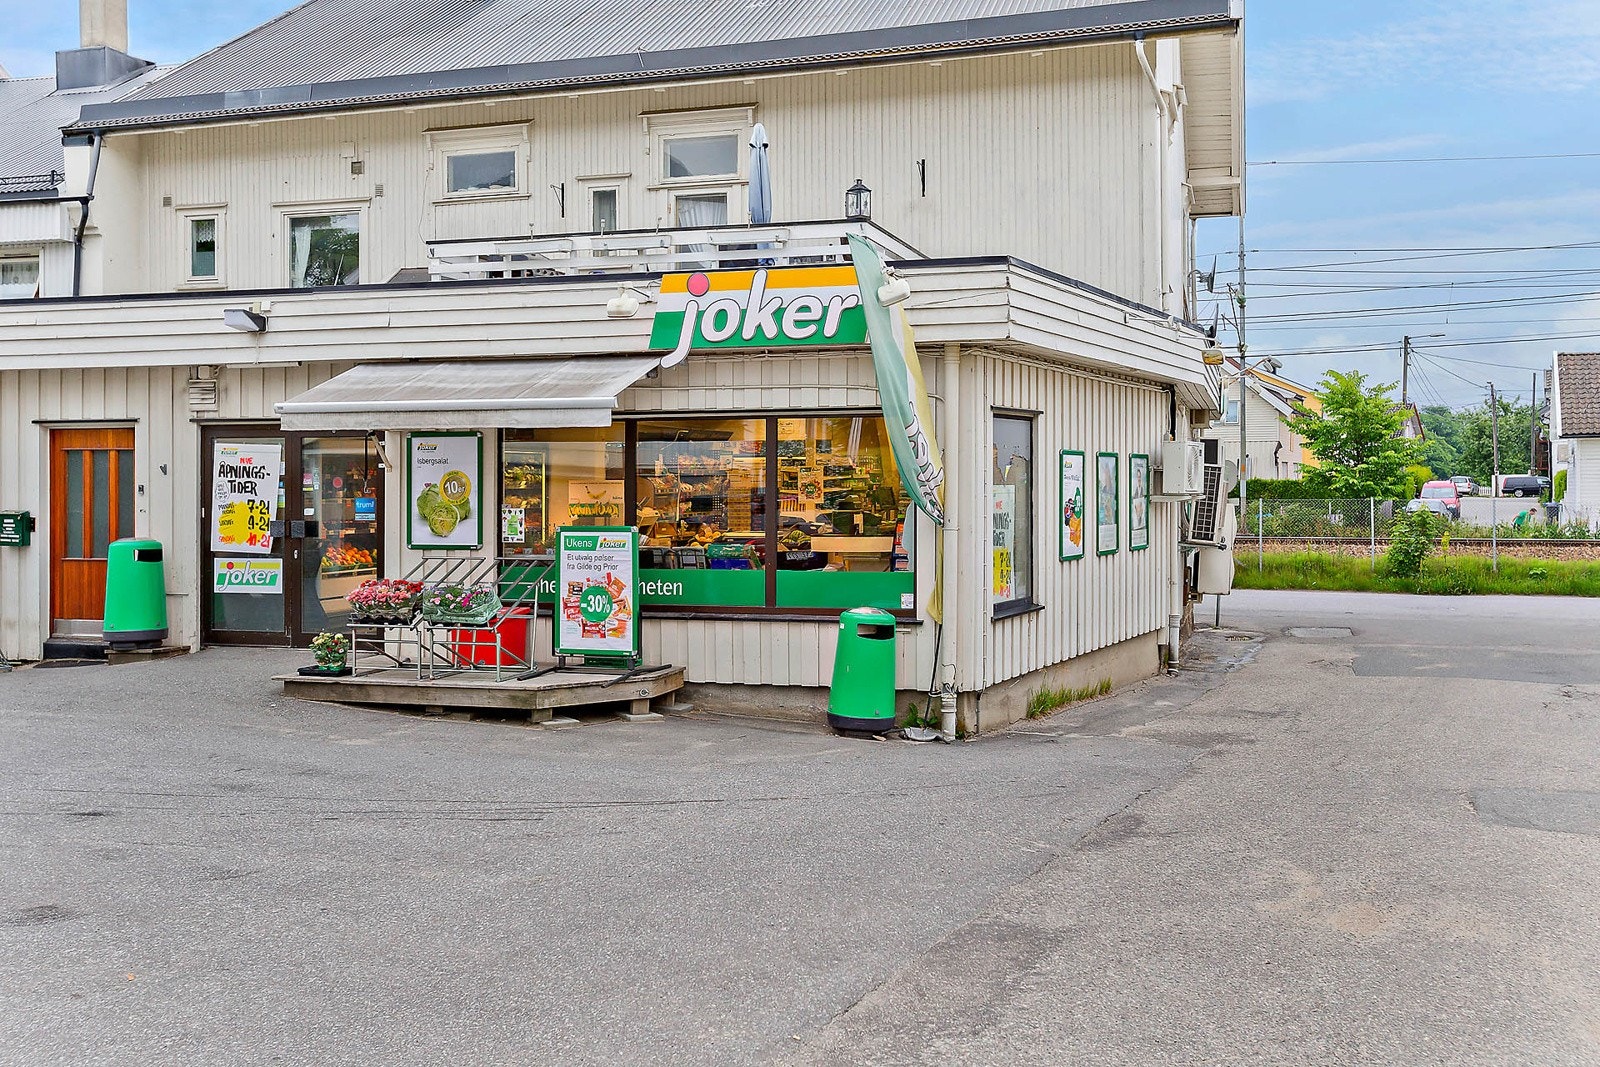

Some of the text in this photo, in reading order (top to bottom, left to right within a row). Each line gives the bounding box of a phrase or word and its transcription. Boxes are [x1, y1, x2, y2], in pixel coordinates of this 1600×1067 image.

[660, 268, 859, 368] joker
[417, 457, 449, 466] Isbergsalat
[227, 479, 258, 497] TIDER
[566, 537, 625, 549] Ukens joker
[566, 562, 619, 572] fra Gilde og Prior
[567, 553, 614, 563] Et utvalg pølser
[218, 560, 276, 591] joker
[638, 577, 683, 596] heten
[580, 594, 611, 613] -30%
